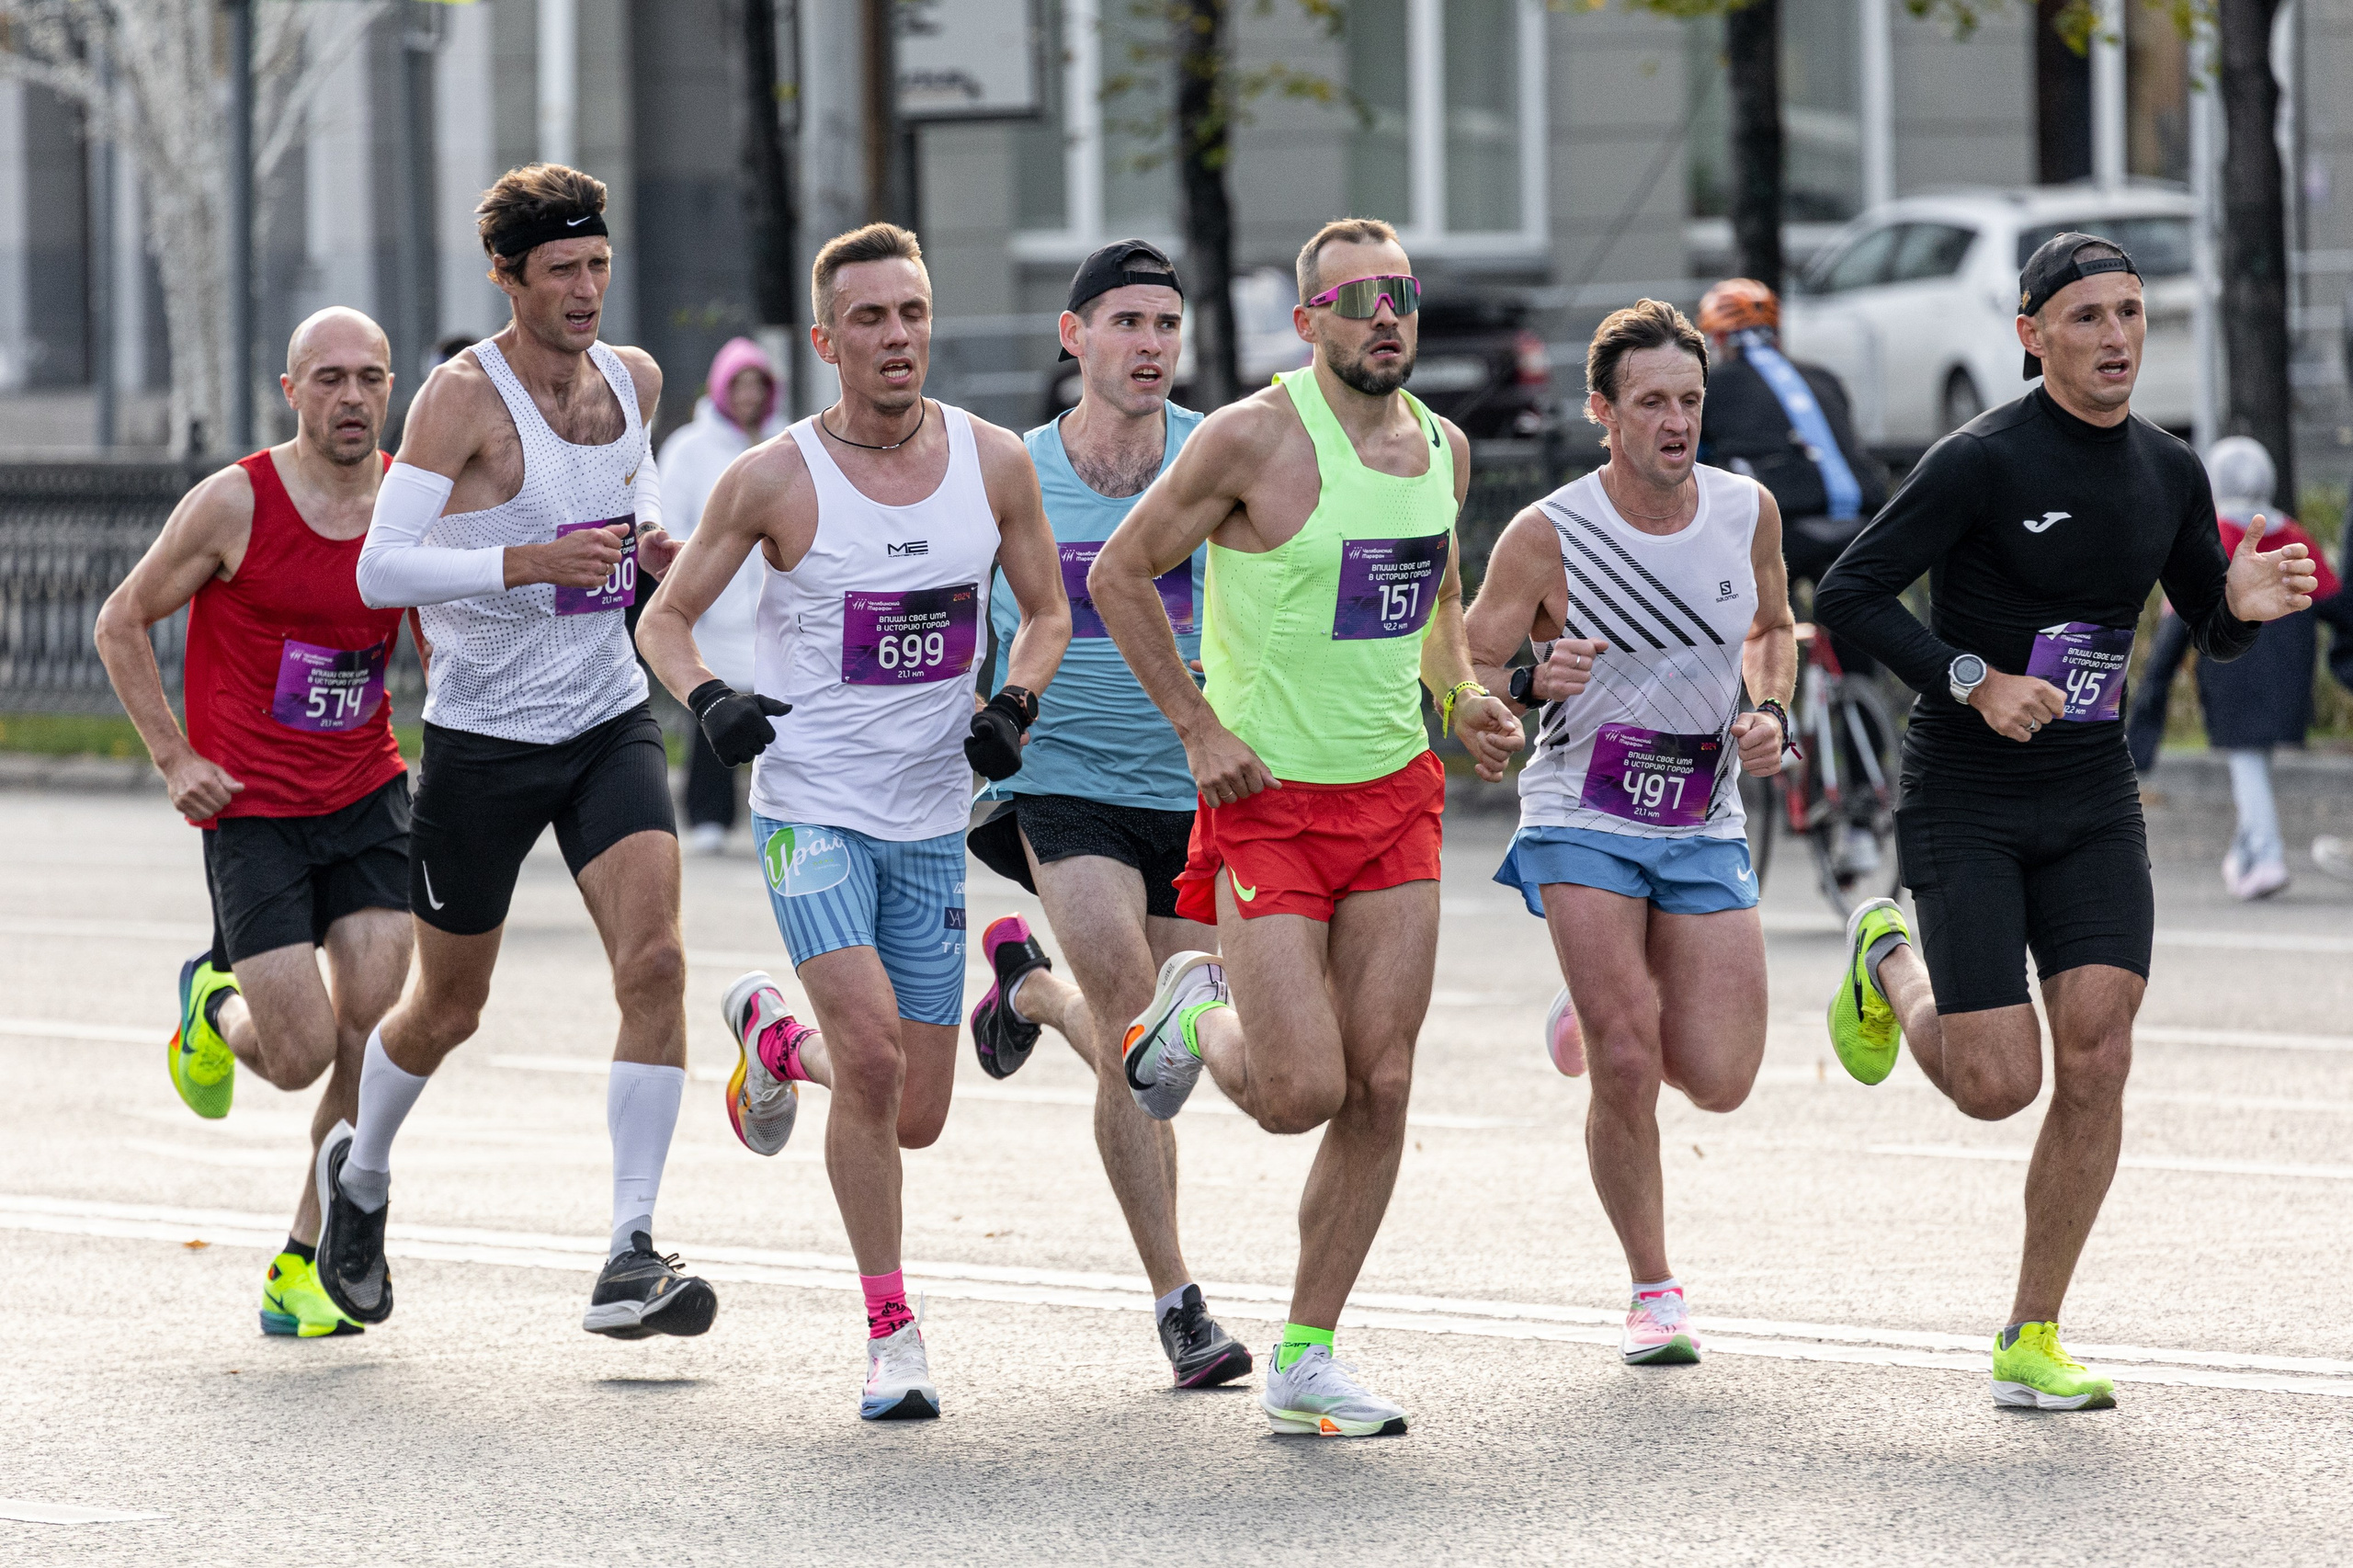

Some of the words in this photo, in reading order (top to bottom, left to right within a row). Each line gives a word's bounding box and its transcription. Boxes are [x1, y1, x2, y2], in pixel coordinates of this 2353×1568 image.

[586, 557, 634, 597] 00
[1375, 571, 1408, 581] ИСТОРИЮ
[1410, 569, 1432, 579] ГОРОДА
[952, 592, 971, 601] 2024
[1379, 583, 1419, 621] 151
[879, 615, 907, 623] ВПИШИ
[908, 613, 928, 622] СВОЕ
[930, 612, 947, 620] ИМЯ
[884, 621, 921, 631] ИСТОРИЮ
[922, 619, 950, 630] ГОРОДА
[1383, 622, 1397, 631] 42,2
[879, 632, 944, 669] 699
[2068, 647, 2091, 658] ВПИШИ
[2092, 652, 2110, 661] СВОЕ
[2068, 656, 2100, 668] ИСТОРИЮ
[897, 670, 911, 678] 21,1
[2066, 669, 2107, 706] 45
[305, 687, 364, 719] 574
[1628, 751, 1654, 761] ВПИШИ
[1656, 755, 1675, 765] СВОЕ
[1677, 757, 1693, 766] ИМЯ
[1631, 761, 1665, 770] ИСТОРИЮ
[1666, 765, 1695, 774] ГОРОДА
[1623, 770, 1686, 810] 497
[1634, 807, 1647, 816] 21,1
